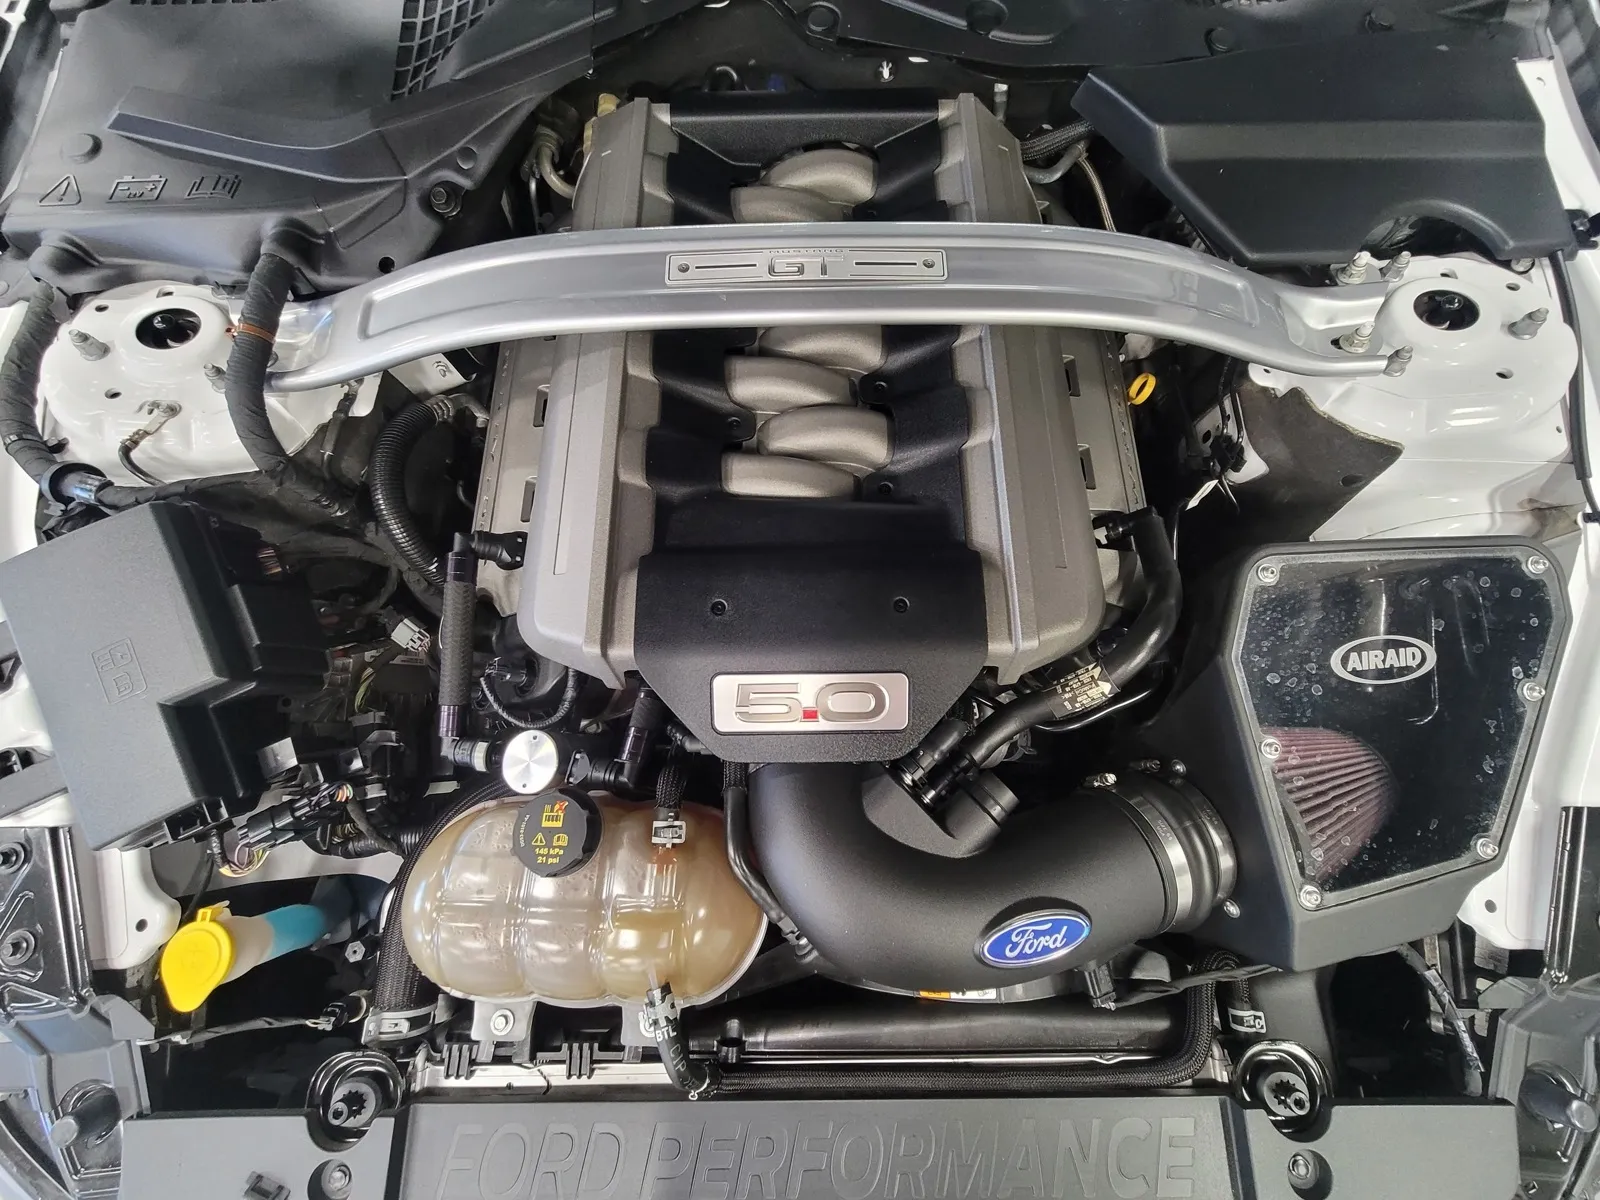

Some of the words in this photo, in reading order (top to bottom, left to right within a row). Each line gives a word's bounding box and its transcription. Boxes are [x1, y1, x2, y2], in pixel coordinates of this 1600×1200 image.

[768, 256, 844, 278] GT
[1346, 646, 1422, 672] AIRAID
[735, 681, 890, 724] 5.0
[537, 856, 546, 864] 21
[547, 856, 560, 865] psi
[1005, 922, 1068, 958] Ford
[655, 1025, 677, 1043] BTL
[435, 1121, 626, 1200] FORD
[638, 1117, 1196, 1200] PERFORMANCE
